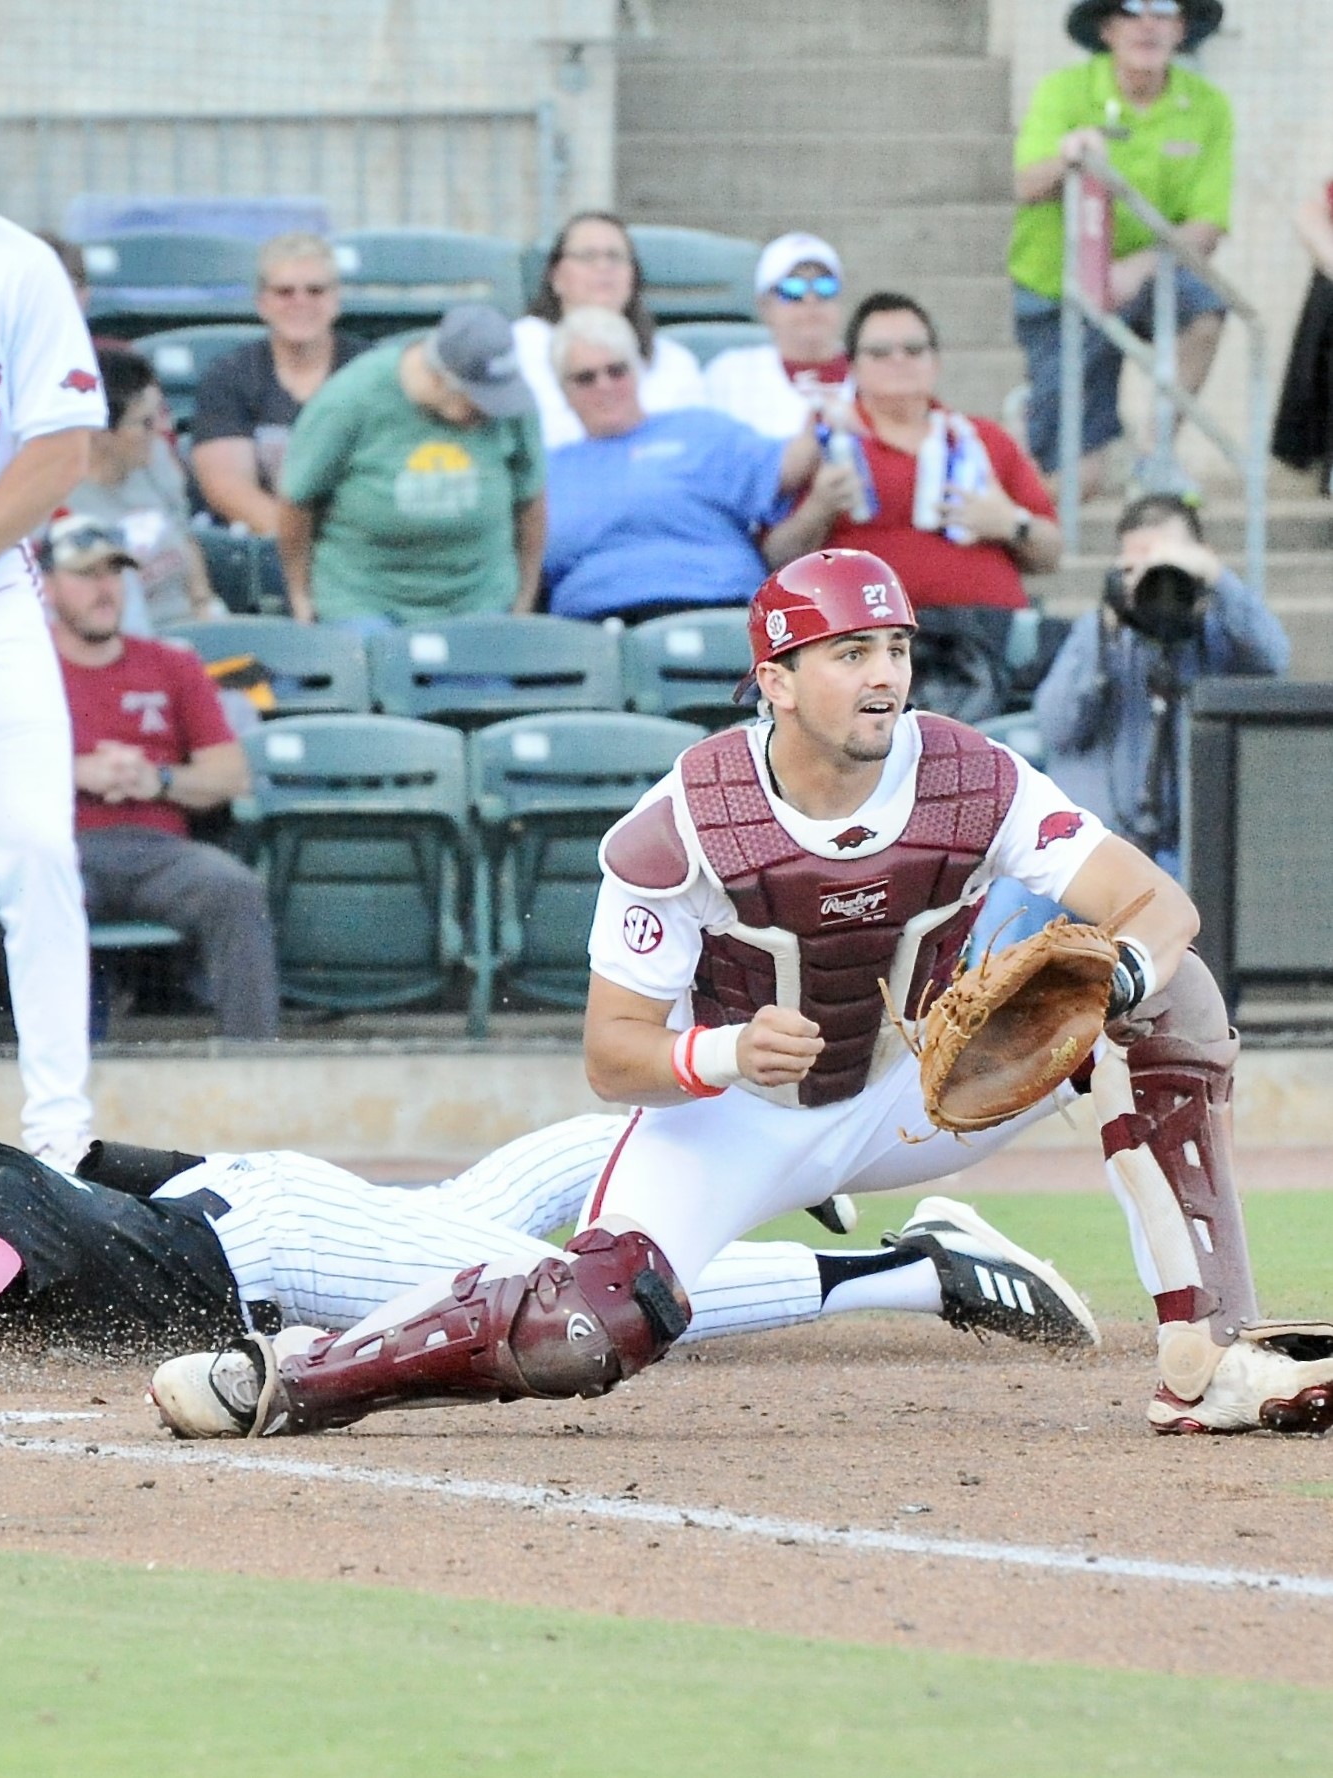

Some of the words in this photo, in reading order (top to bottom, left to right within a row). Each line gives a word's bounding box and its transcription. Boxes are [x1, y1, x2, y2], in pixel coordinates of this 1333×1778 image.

[862, 584, 887, 606] 27
[820, 890, 888, 915] Rawlings
[623, 905, 663, 954] SEC
